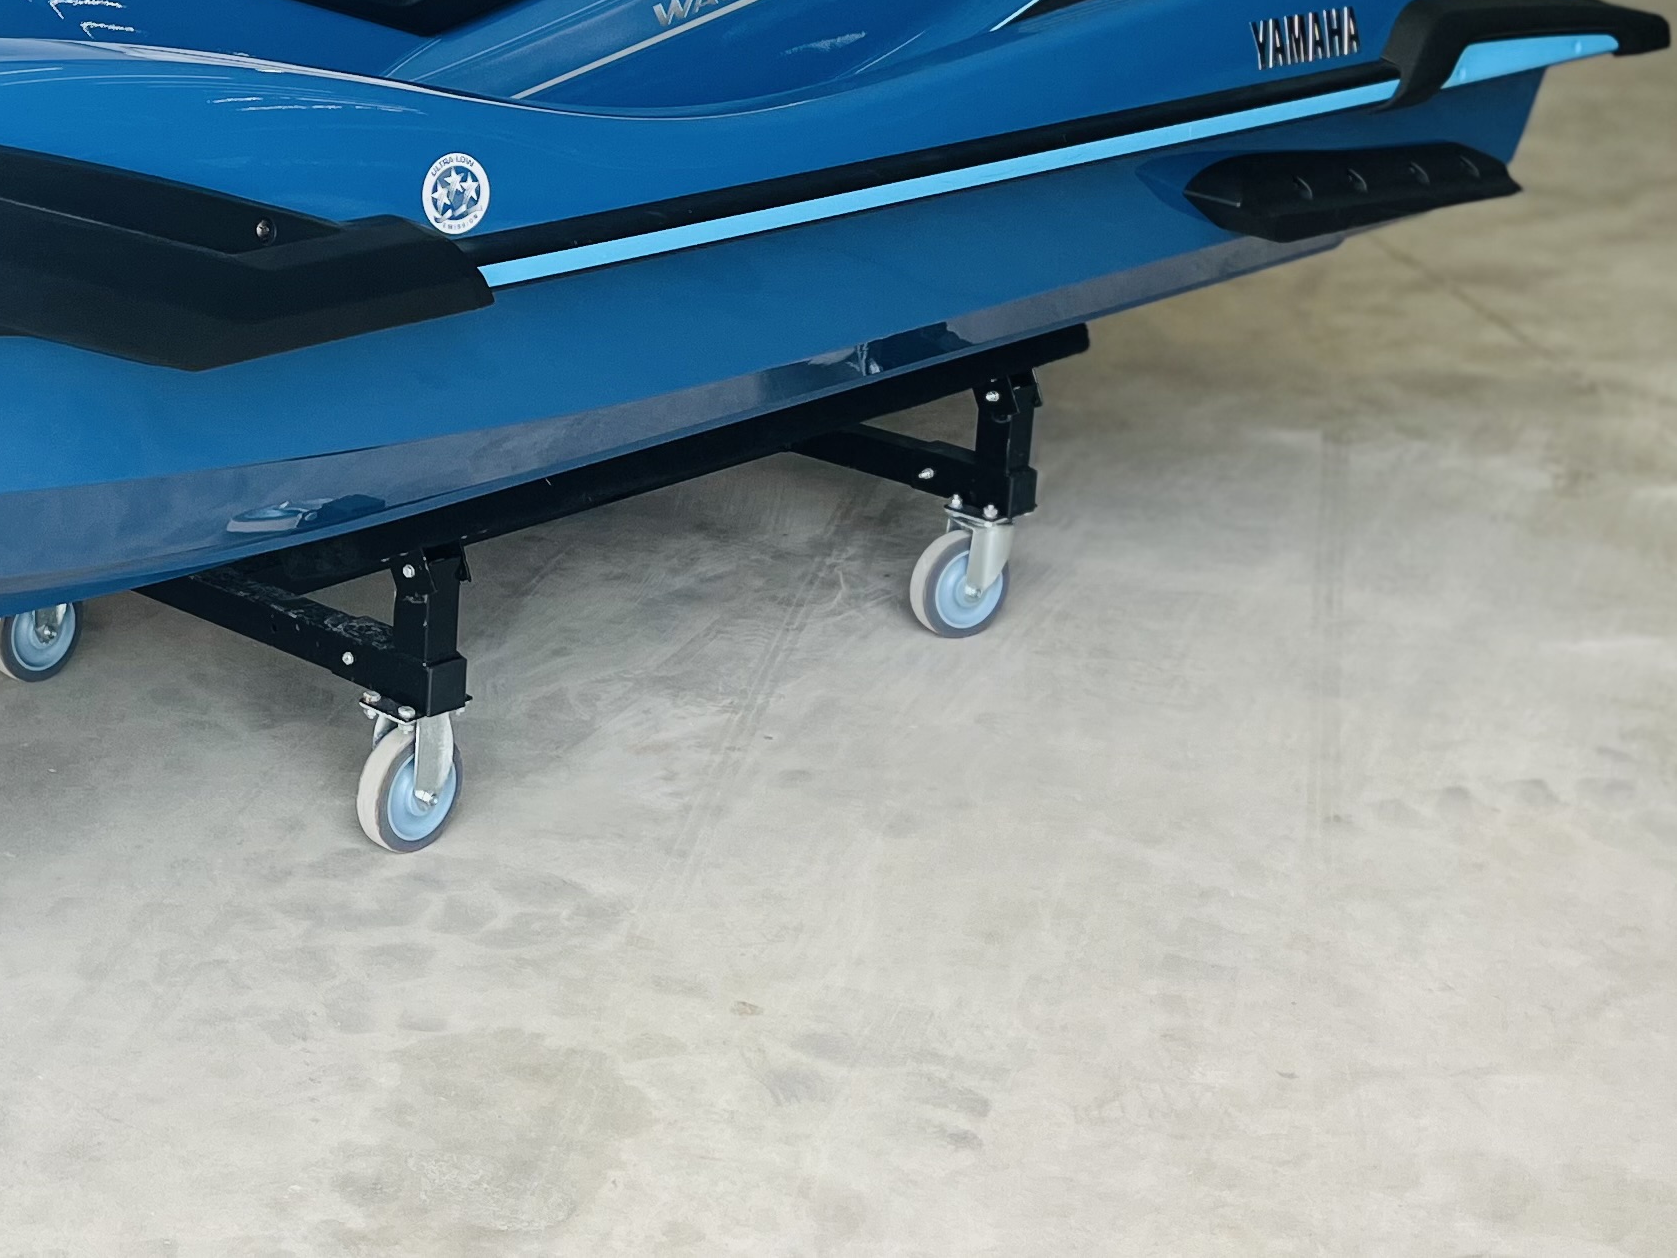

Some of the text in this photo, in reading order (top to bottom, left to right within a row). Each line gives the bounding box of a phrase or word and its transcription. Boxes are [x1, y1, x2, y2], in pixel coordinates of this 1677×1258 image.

[1248, 5, 1361, 71] YAMAHA
[431, 155, 475, 177] ULTRA LOW
